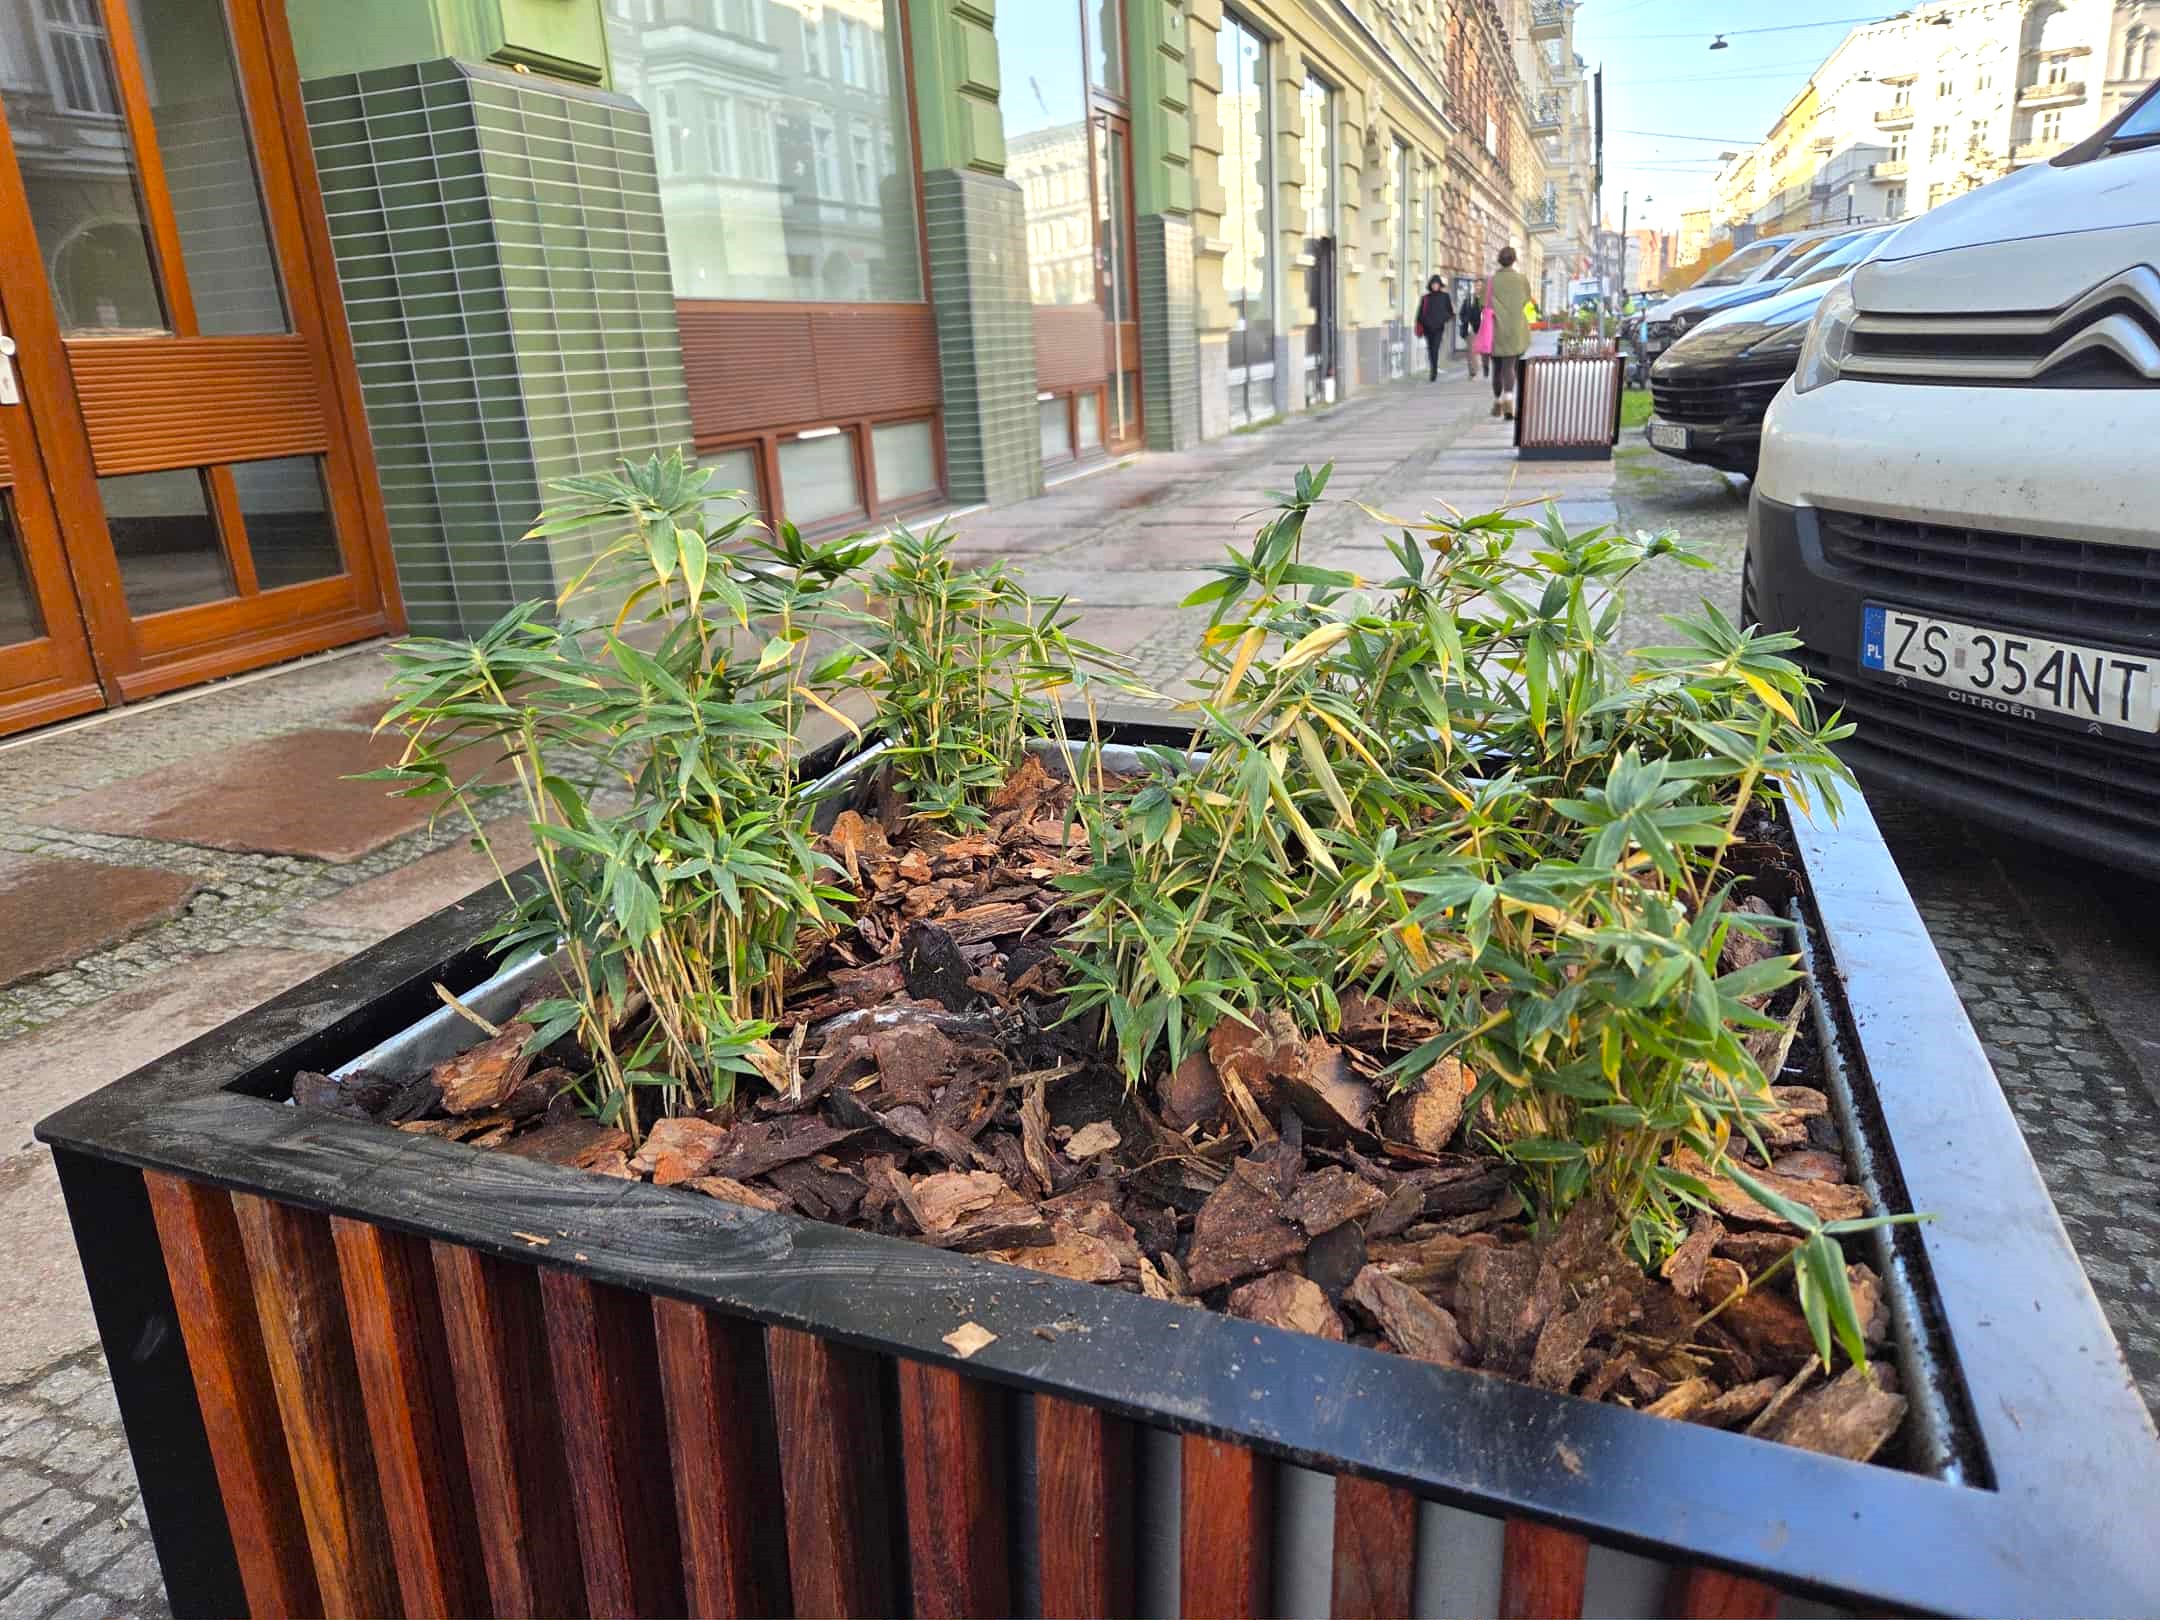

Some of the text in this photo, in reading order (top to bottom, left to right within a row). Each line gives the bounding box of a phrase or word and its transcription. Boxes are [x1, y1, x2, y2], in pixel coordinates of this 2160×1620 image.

[1867, 643, 1882, 659] PL
[1893, 617, 2148, 722] ZS 354NT
